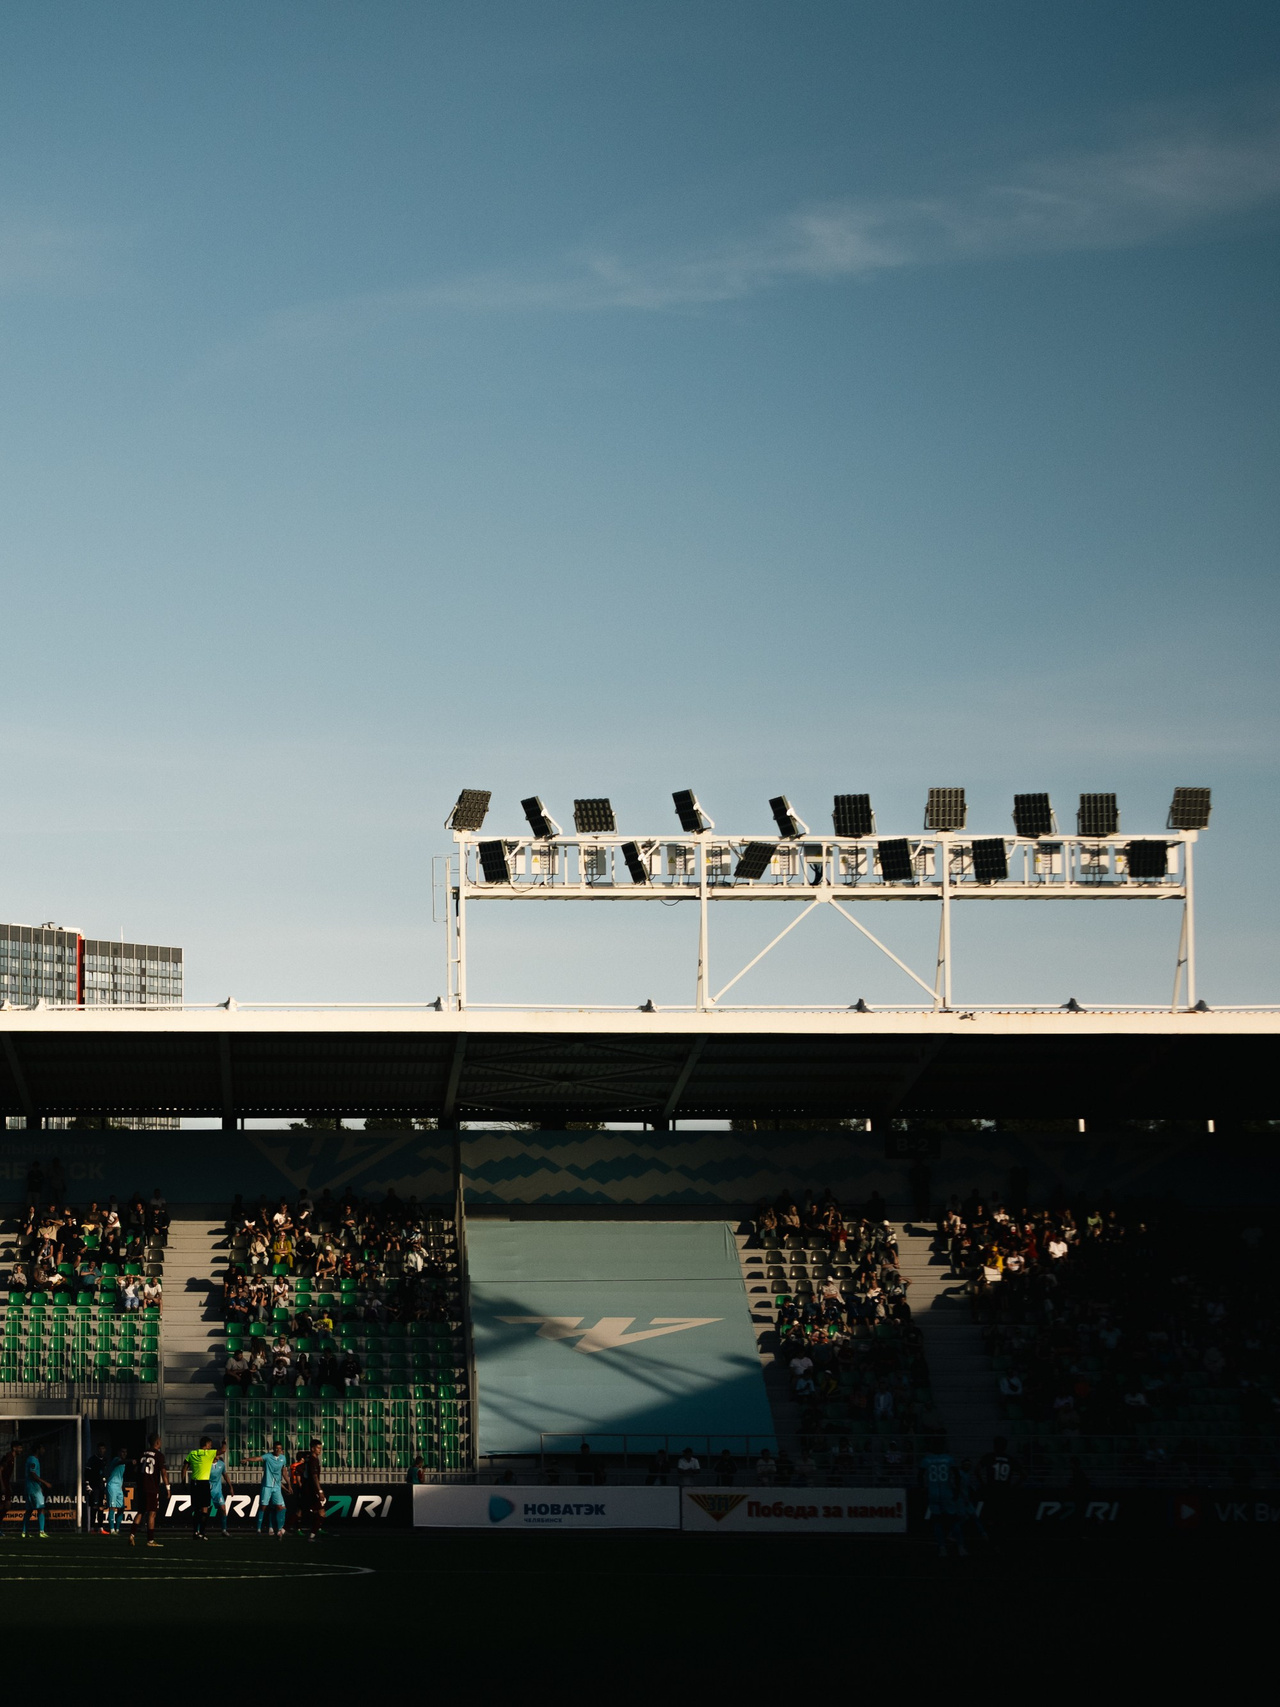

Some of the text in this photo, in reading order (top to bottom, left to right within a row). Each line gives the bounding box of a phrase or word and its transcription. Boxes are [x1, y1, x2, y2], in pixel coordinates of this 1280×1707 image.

[928, 1463, 950, 1482] 88
[991, 1461, 1011, 1481] 19
[524, 1503, 606, 1516] НОВАТЭК
[746, 1501, 902, 1519] Победа за нами!
[1214, 1502, 1249, 1522] VK
